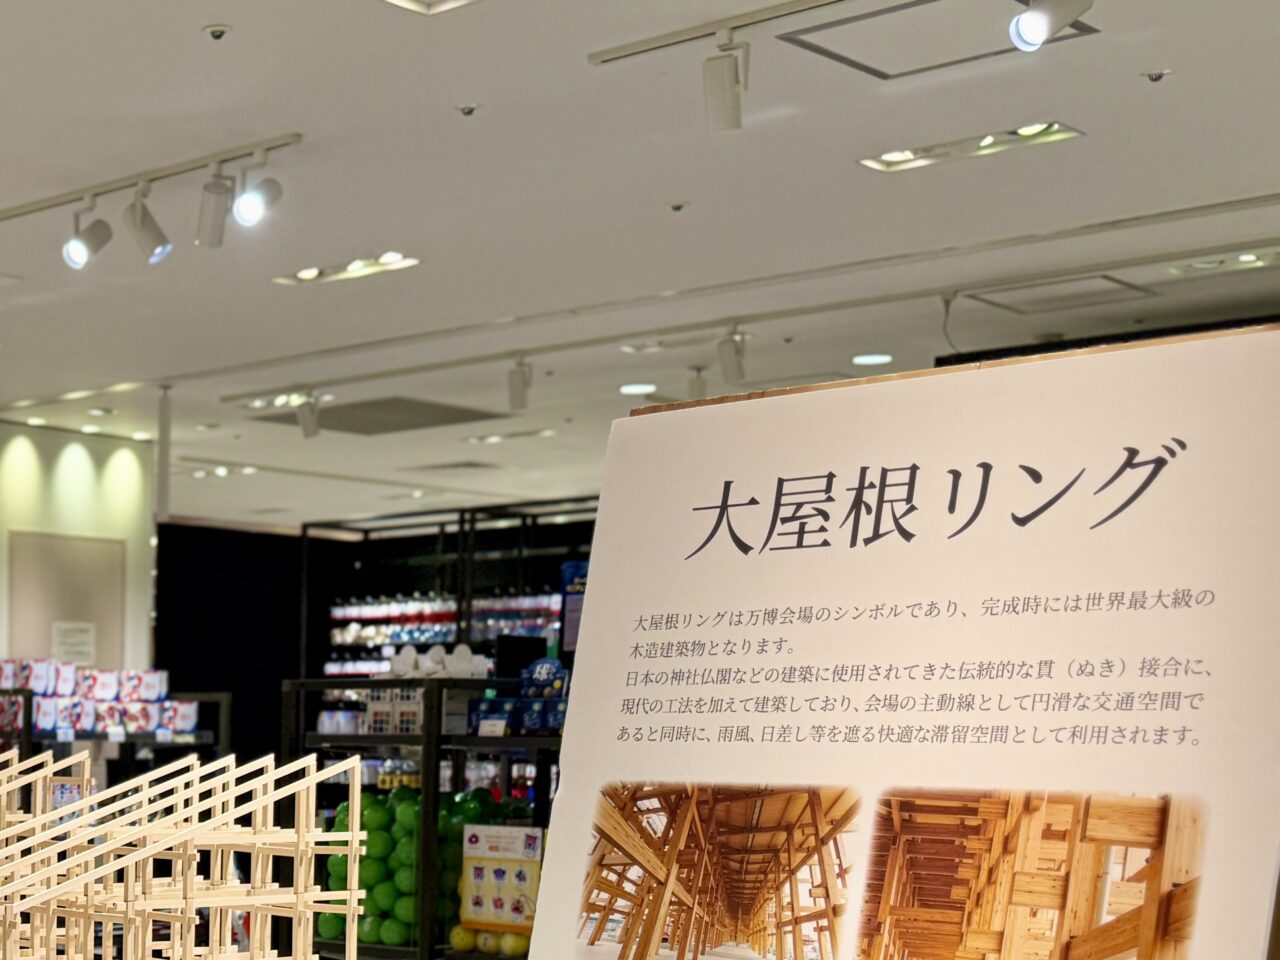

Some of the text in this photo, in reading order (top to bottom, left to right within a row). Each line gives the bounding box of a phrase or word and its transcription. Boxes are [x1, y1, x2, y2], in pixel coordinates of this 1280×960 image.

[684, 437, 1188, 561] 大屋根リング
[632, 588, 1215, 632] 大屋根リングは万博会場のシンボルであり、完成時には世界最大級の
[629, 637, 794, 660] 木造建築物となります。
